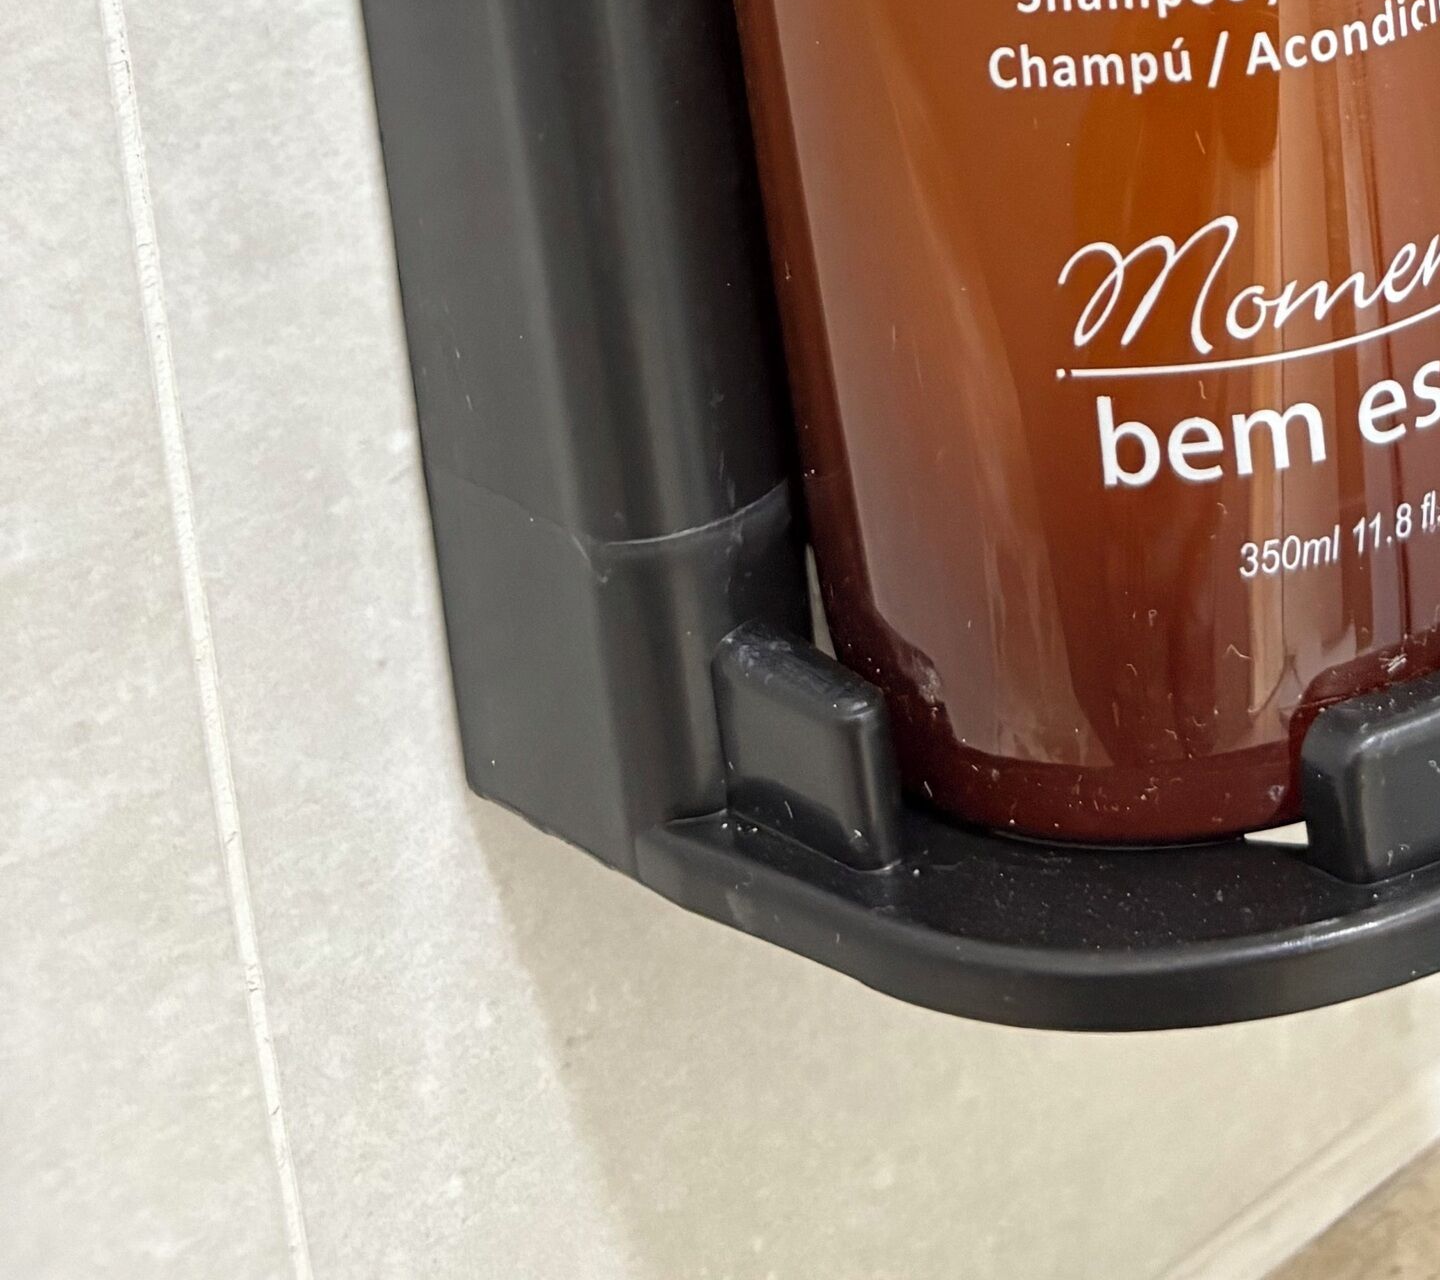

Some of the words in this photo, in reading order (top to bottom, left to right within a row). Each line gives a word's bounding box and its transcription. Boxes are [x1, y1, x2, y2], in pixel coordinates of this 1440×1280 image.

[987, 36, 1193, 95] Champú
[1206, 30, 1229, 89] /
[1096, 395, 1328, 489] bem
[1239, 525, 1341, 578] 350ml
[1352, 502, 1413, 554] 11.8
